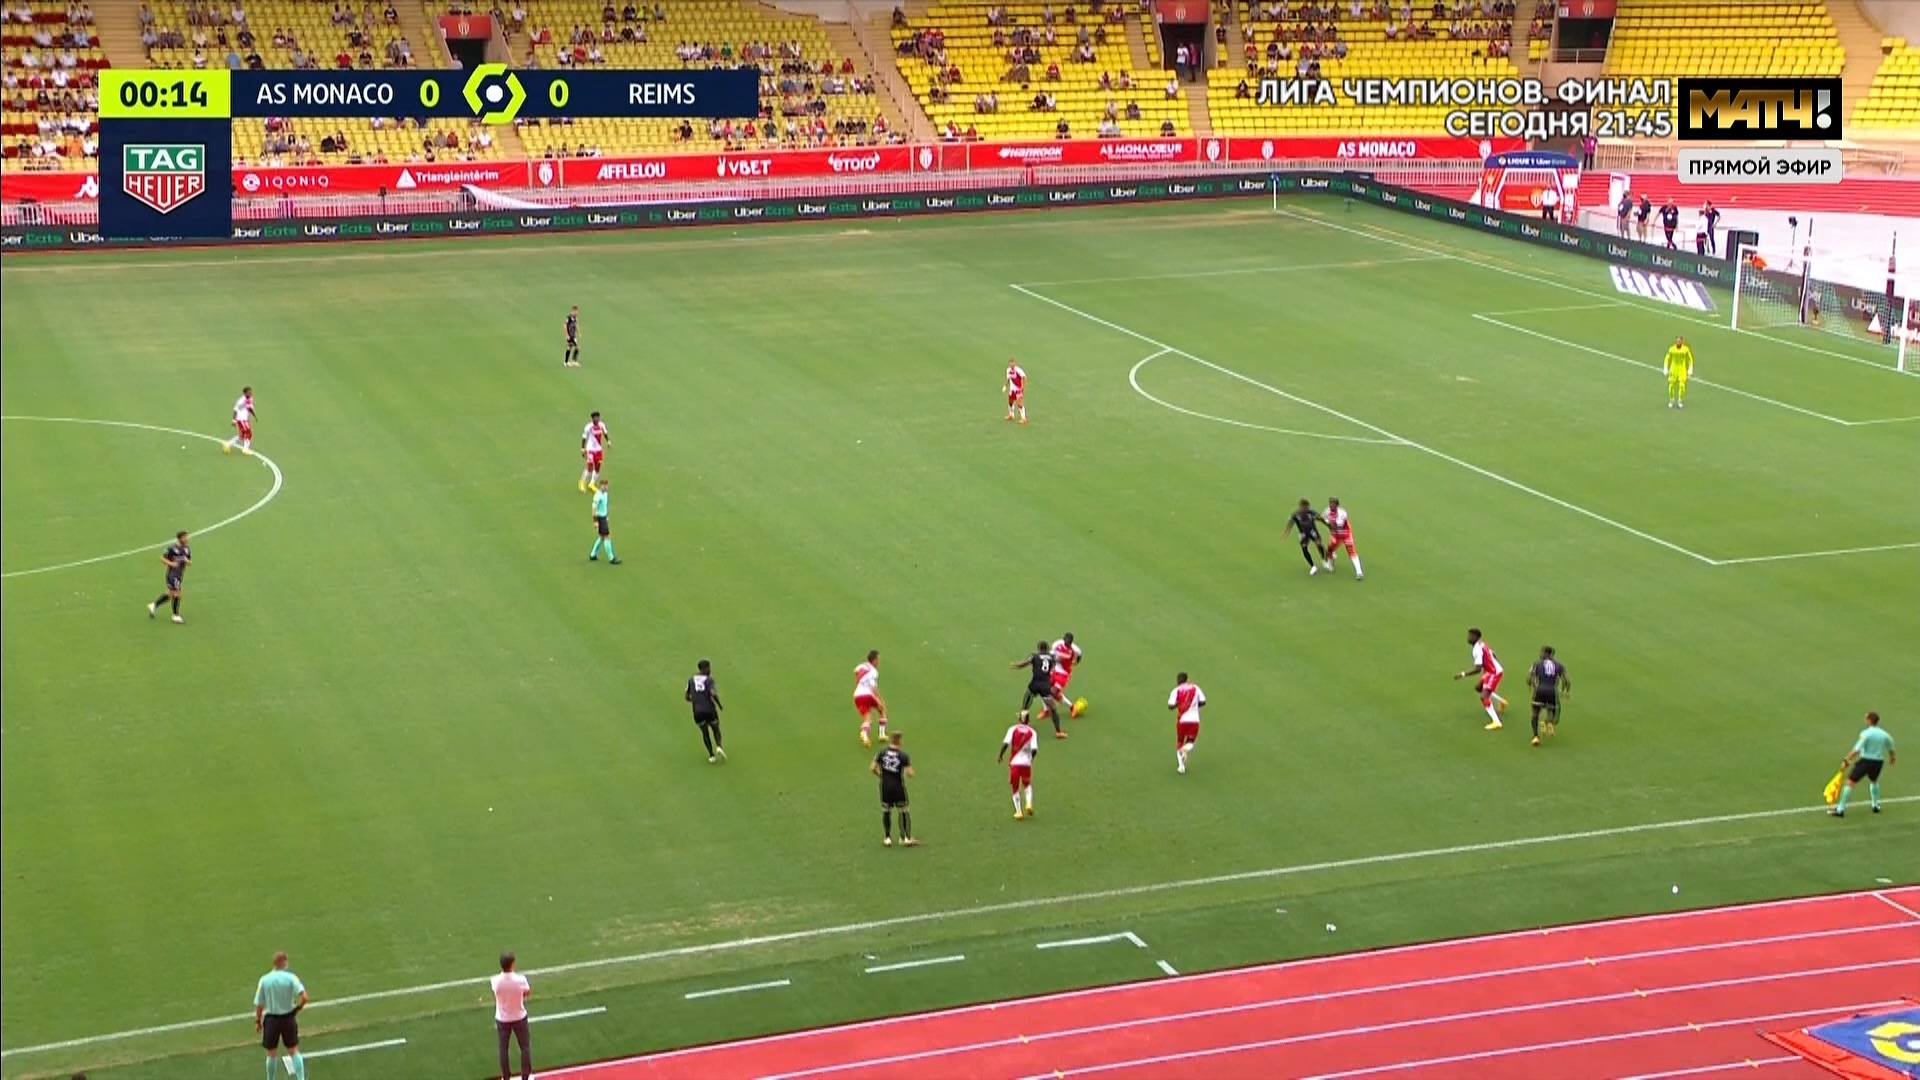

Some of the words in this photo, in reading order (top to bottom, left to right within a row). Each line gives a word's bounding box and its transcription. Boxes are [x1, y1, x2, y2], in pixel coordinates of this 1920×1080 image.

[1337, 142, 1356, 157] AS
[1358, 142, 1416, 157] MONACO
[597, 162, 666, 180] AFFLELOU
[729, 159, 772, 176] VBET
[265, 175, 329, 187] IQONIQ
[1239, 179, 1265, 191] Uber
[1300, 177, 1331, 189] Uber
[1110, 187, 1137, 198] Uber
[1168, 183, 1195, 194] Uber
[987, 194, 1015, 205] Uber
[1049, 191, 1076, 201] Uber
[862, 199, 890, 211] Uber
[926, 197, 953, 208] Uber
[667, 209, 696, 220] Uber
[734, 206, 764, 218] Uber
[798, 203, 826, 215] Uber
[449, 218, 480, 230] Uber
[520, 215, 550, 227] Uber
[587, 212, 618, 224] Uber
[1484, 214, 1500, 226] Uber
[304, 224, 337, 236] Uber
[377, 221, 408, 233] Uber
[1521, 223, 1540, 237] Uber
[1, 234, 22, 245] ber
[1560, 232, 1579, 246] Uber
[1608, 244, 1628, 258] Uber
[1652, 254, 1672, 268] Uber
[1697, 263, 1720, 278] Uber
